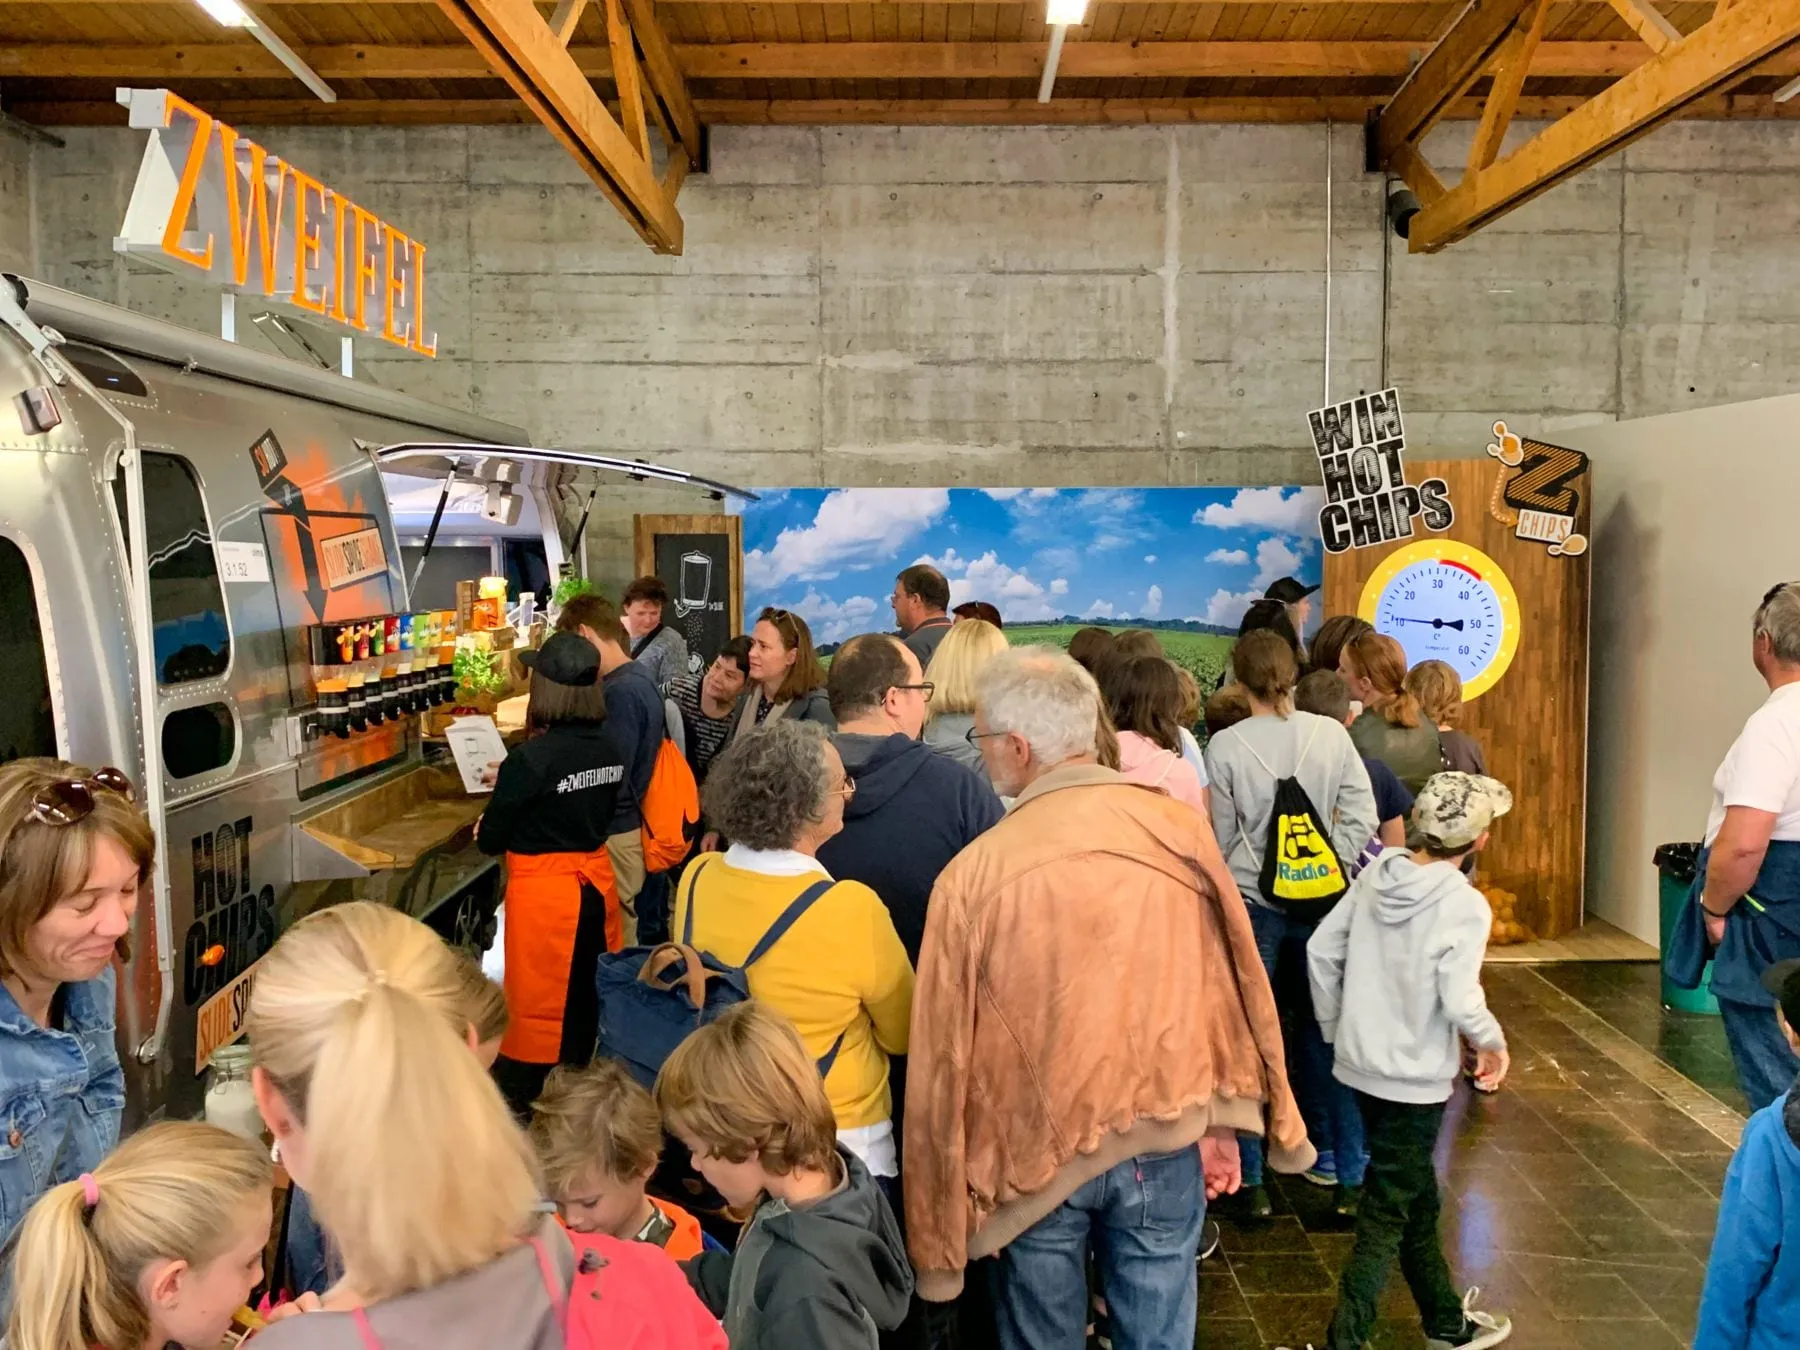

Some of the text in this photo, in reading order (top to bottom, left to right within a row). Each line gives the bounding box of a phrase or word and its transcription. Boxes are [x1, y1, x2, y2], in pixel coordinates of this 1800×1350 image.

[161, 89, 438, 358] ZWEIFEL
[1308, 390, 1403, 456] WIN
[1321, 438, 1404, 503] HOT
[1320, 480, 1453, 553] CHIPS
[1519, 511, 1568, 540] CHIPS
[1404, 591, 1415, 600] 20
[1432, 579, 1443, 589] 30
[1458, 591, 1470, 600] 40
[1396, 617, 1405, 627] 10
[1470, 619, 1481, 629] 50
[1458, 645, 1470, 655] 60
[192, 815, 253, 921] HOT
[1279, 863, 1329, 881] Radio
[184, 884, 275, 1006] CHIPS
